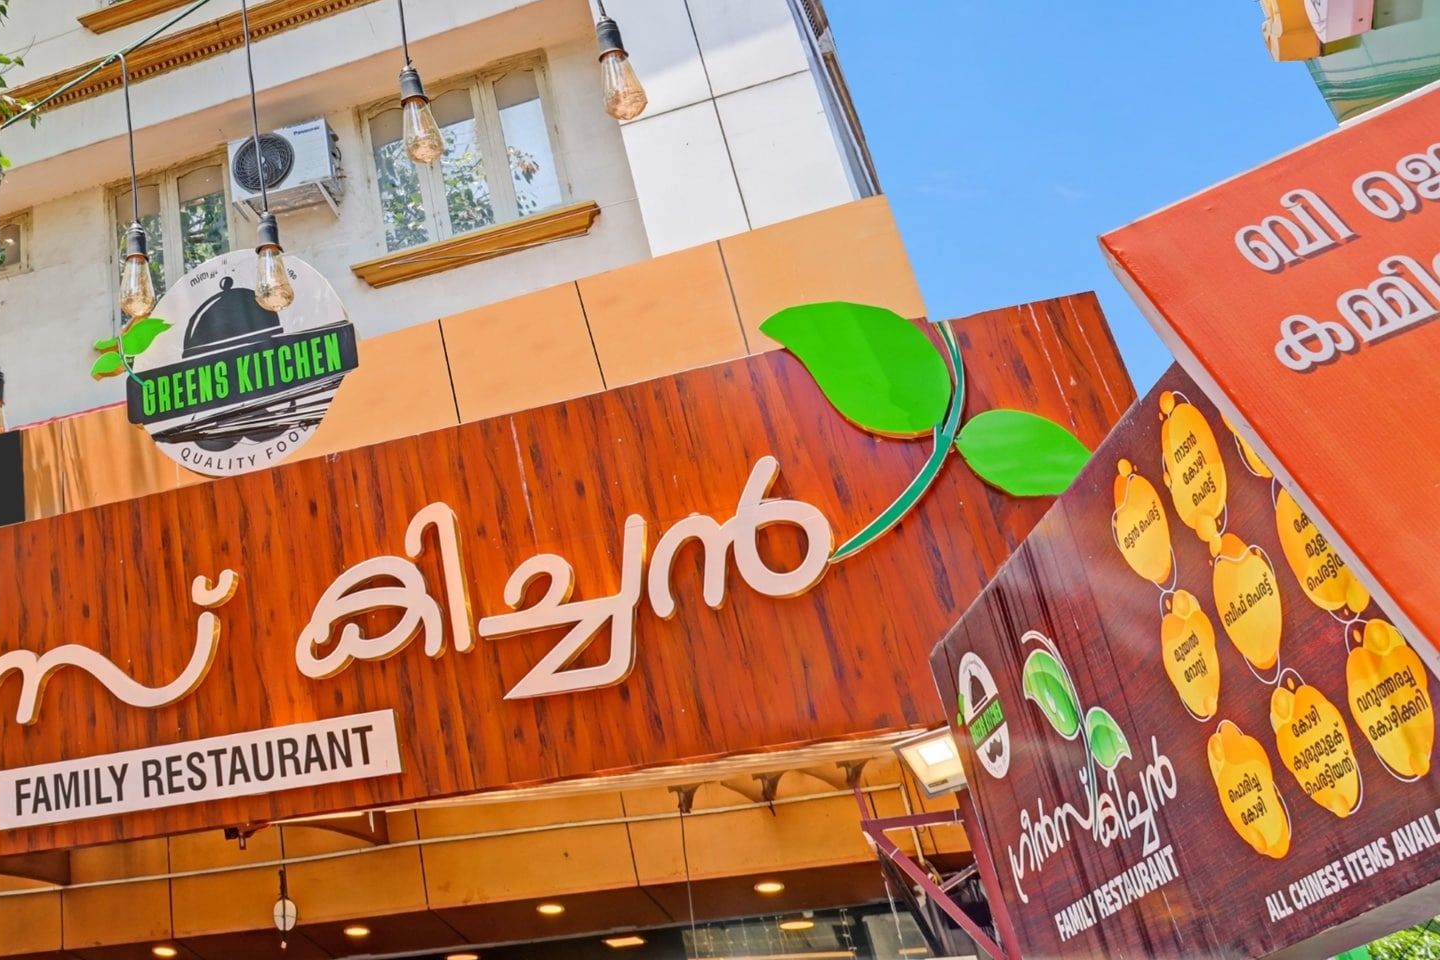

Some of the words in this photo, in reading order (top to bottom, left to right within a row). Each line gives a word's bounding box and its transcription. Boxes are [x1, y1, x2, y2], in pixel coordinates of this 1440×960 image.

[1234, 189, 1356, 271] ബി
[1274, 254, 1440, 371] കമ്മി
[142, 360, 229, 417] GREENS
[236, 333, 342, 394] KITCHEN
[181, 447, 256, 470] QUALITY
[1182, 450, 1207, 485] കോഴി
[295, 455, 835, 699] കിച്ചൻ
[1292, 705, 1321, 737] കോഴി
[1357, 665, 1416, 713] വറുത്തരച്ച
[1369, 688, 1428, 740] കോഴിക്കറി
[15, 763, 129, 816] FAMILY
[141, 725, 373, 798] RESTAURANT
[1241, 796, 1267, 825] കോഴി
[1054, 894, 1098, 942] FAMILY
[1094, 844, 1180, 919] RESTAURANT
[1265, 890, 1294, 922] ALL
[1288, 860, 1349, 910] CHINESE
[1343, 837, 1395, 883] ITEMS
[1391, 808, 1440, 861] AVAIL
